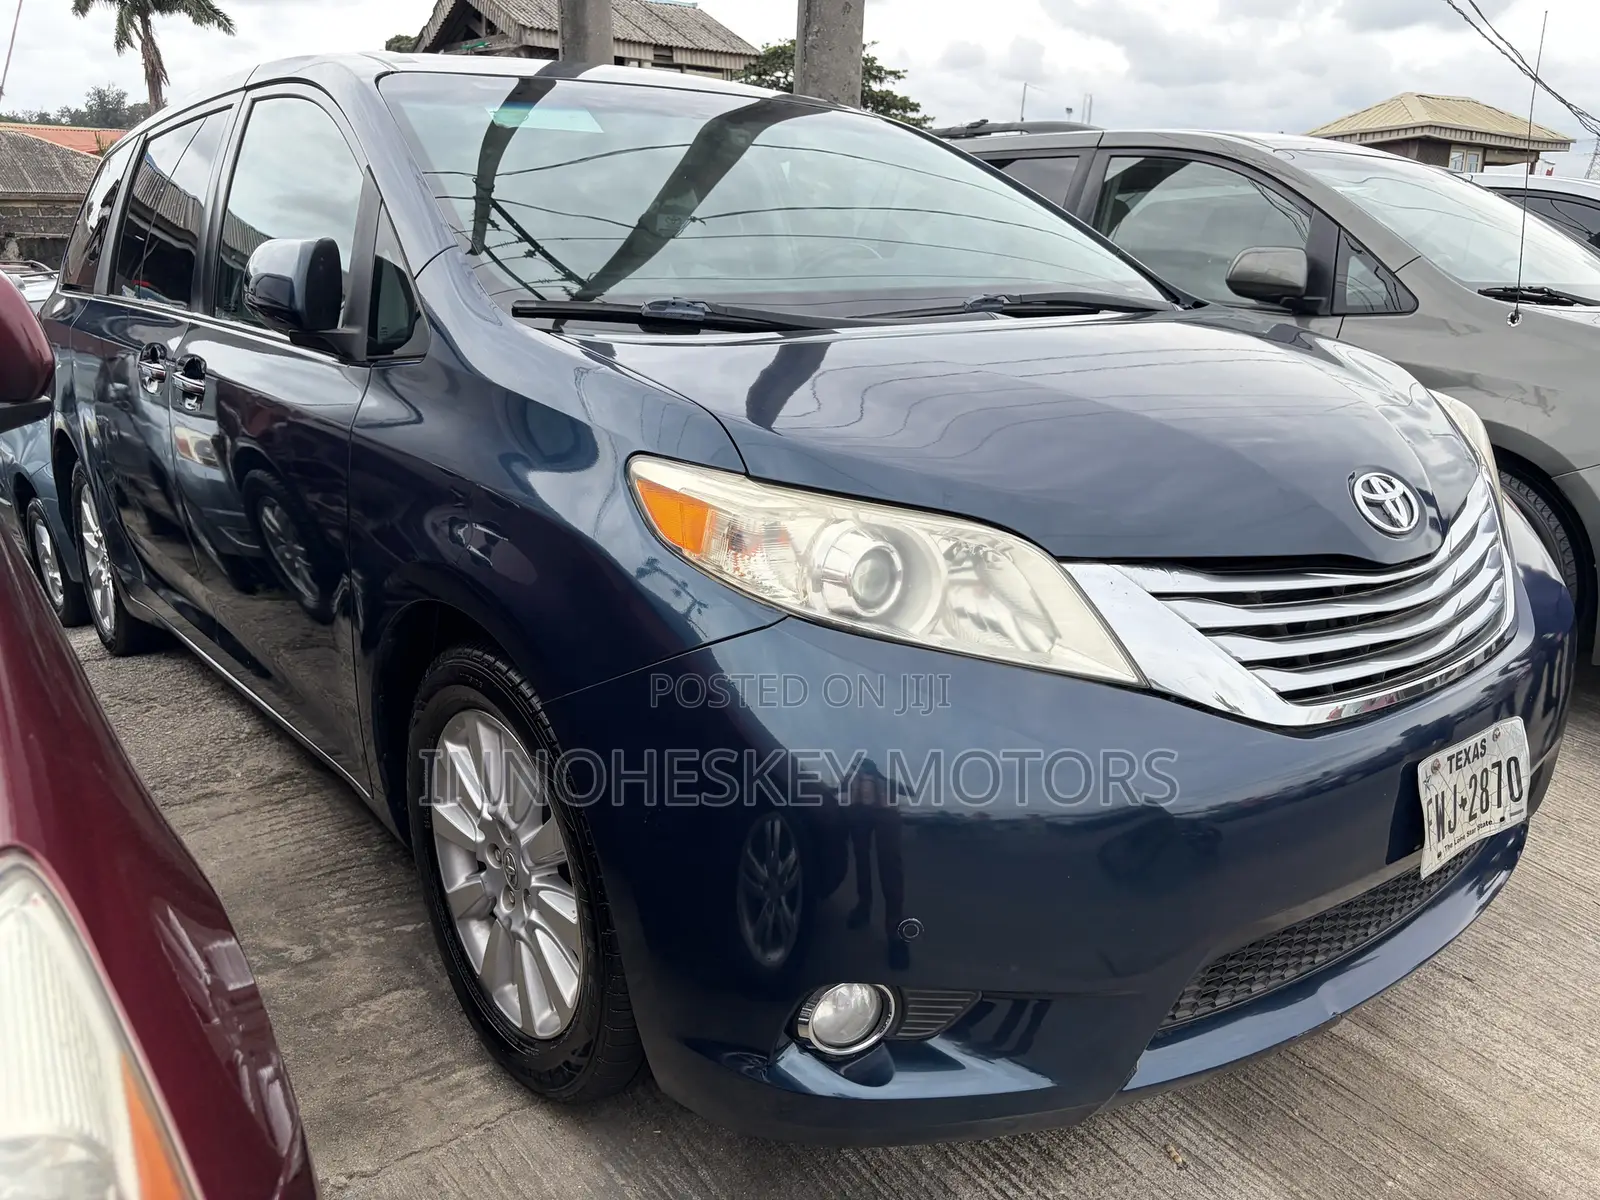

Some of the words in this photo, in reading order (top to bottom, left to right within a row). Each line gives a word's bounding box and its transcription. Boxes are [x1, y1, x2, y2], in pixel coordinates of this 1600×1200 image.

[1447, 738, 1487, 774] TEXAS
[1466, 827, 1477, 838] Star
[1477, 820, 1493, 831] State
